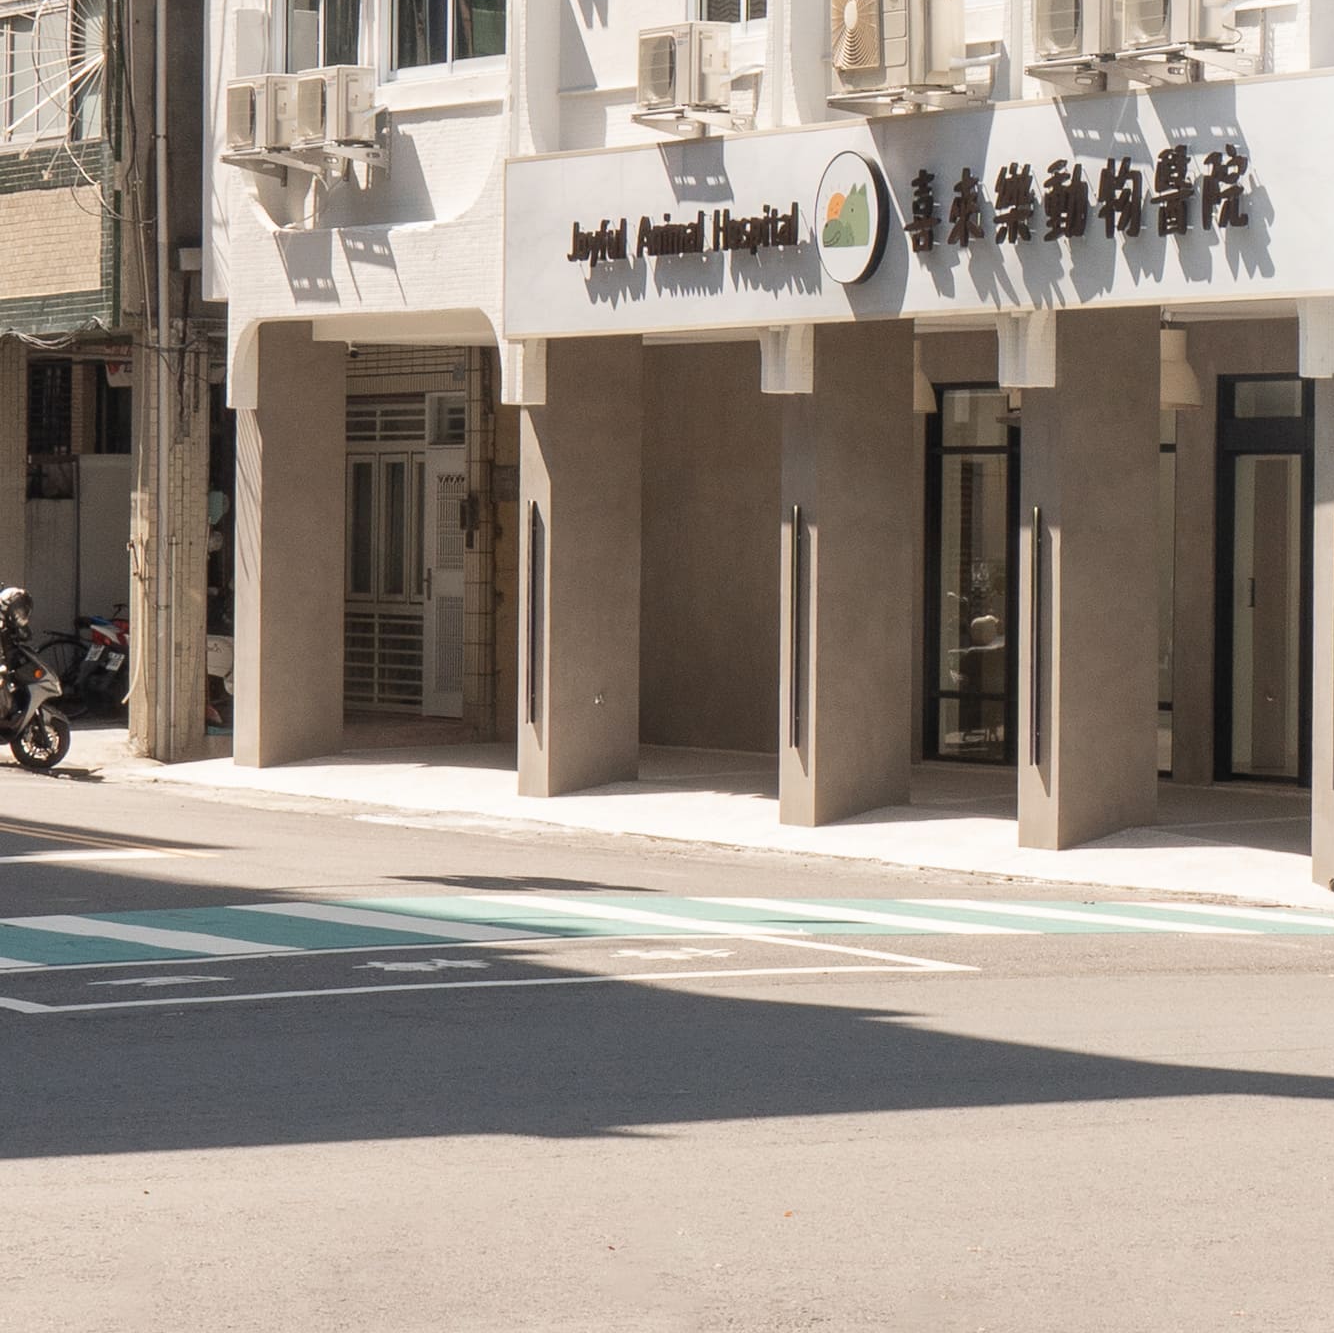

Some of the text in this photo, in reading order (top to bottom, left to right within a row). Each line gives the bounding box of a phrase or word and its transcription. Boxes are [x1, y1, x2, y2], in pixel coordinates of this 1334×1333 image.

[567, 202, 799, 267] Joyful Animal Hospital
[904, 144, 1248, 254] 喜來樂動物醫院
